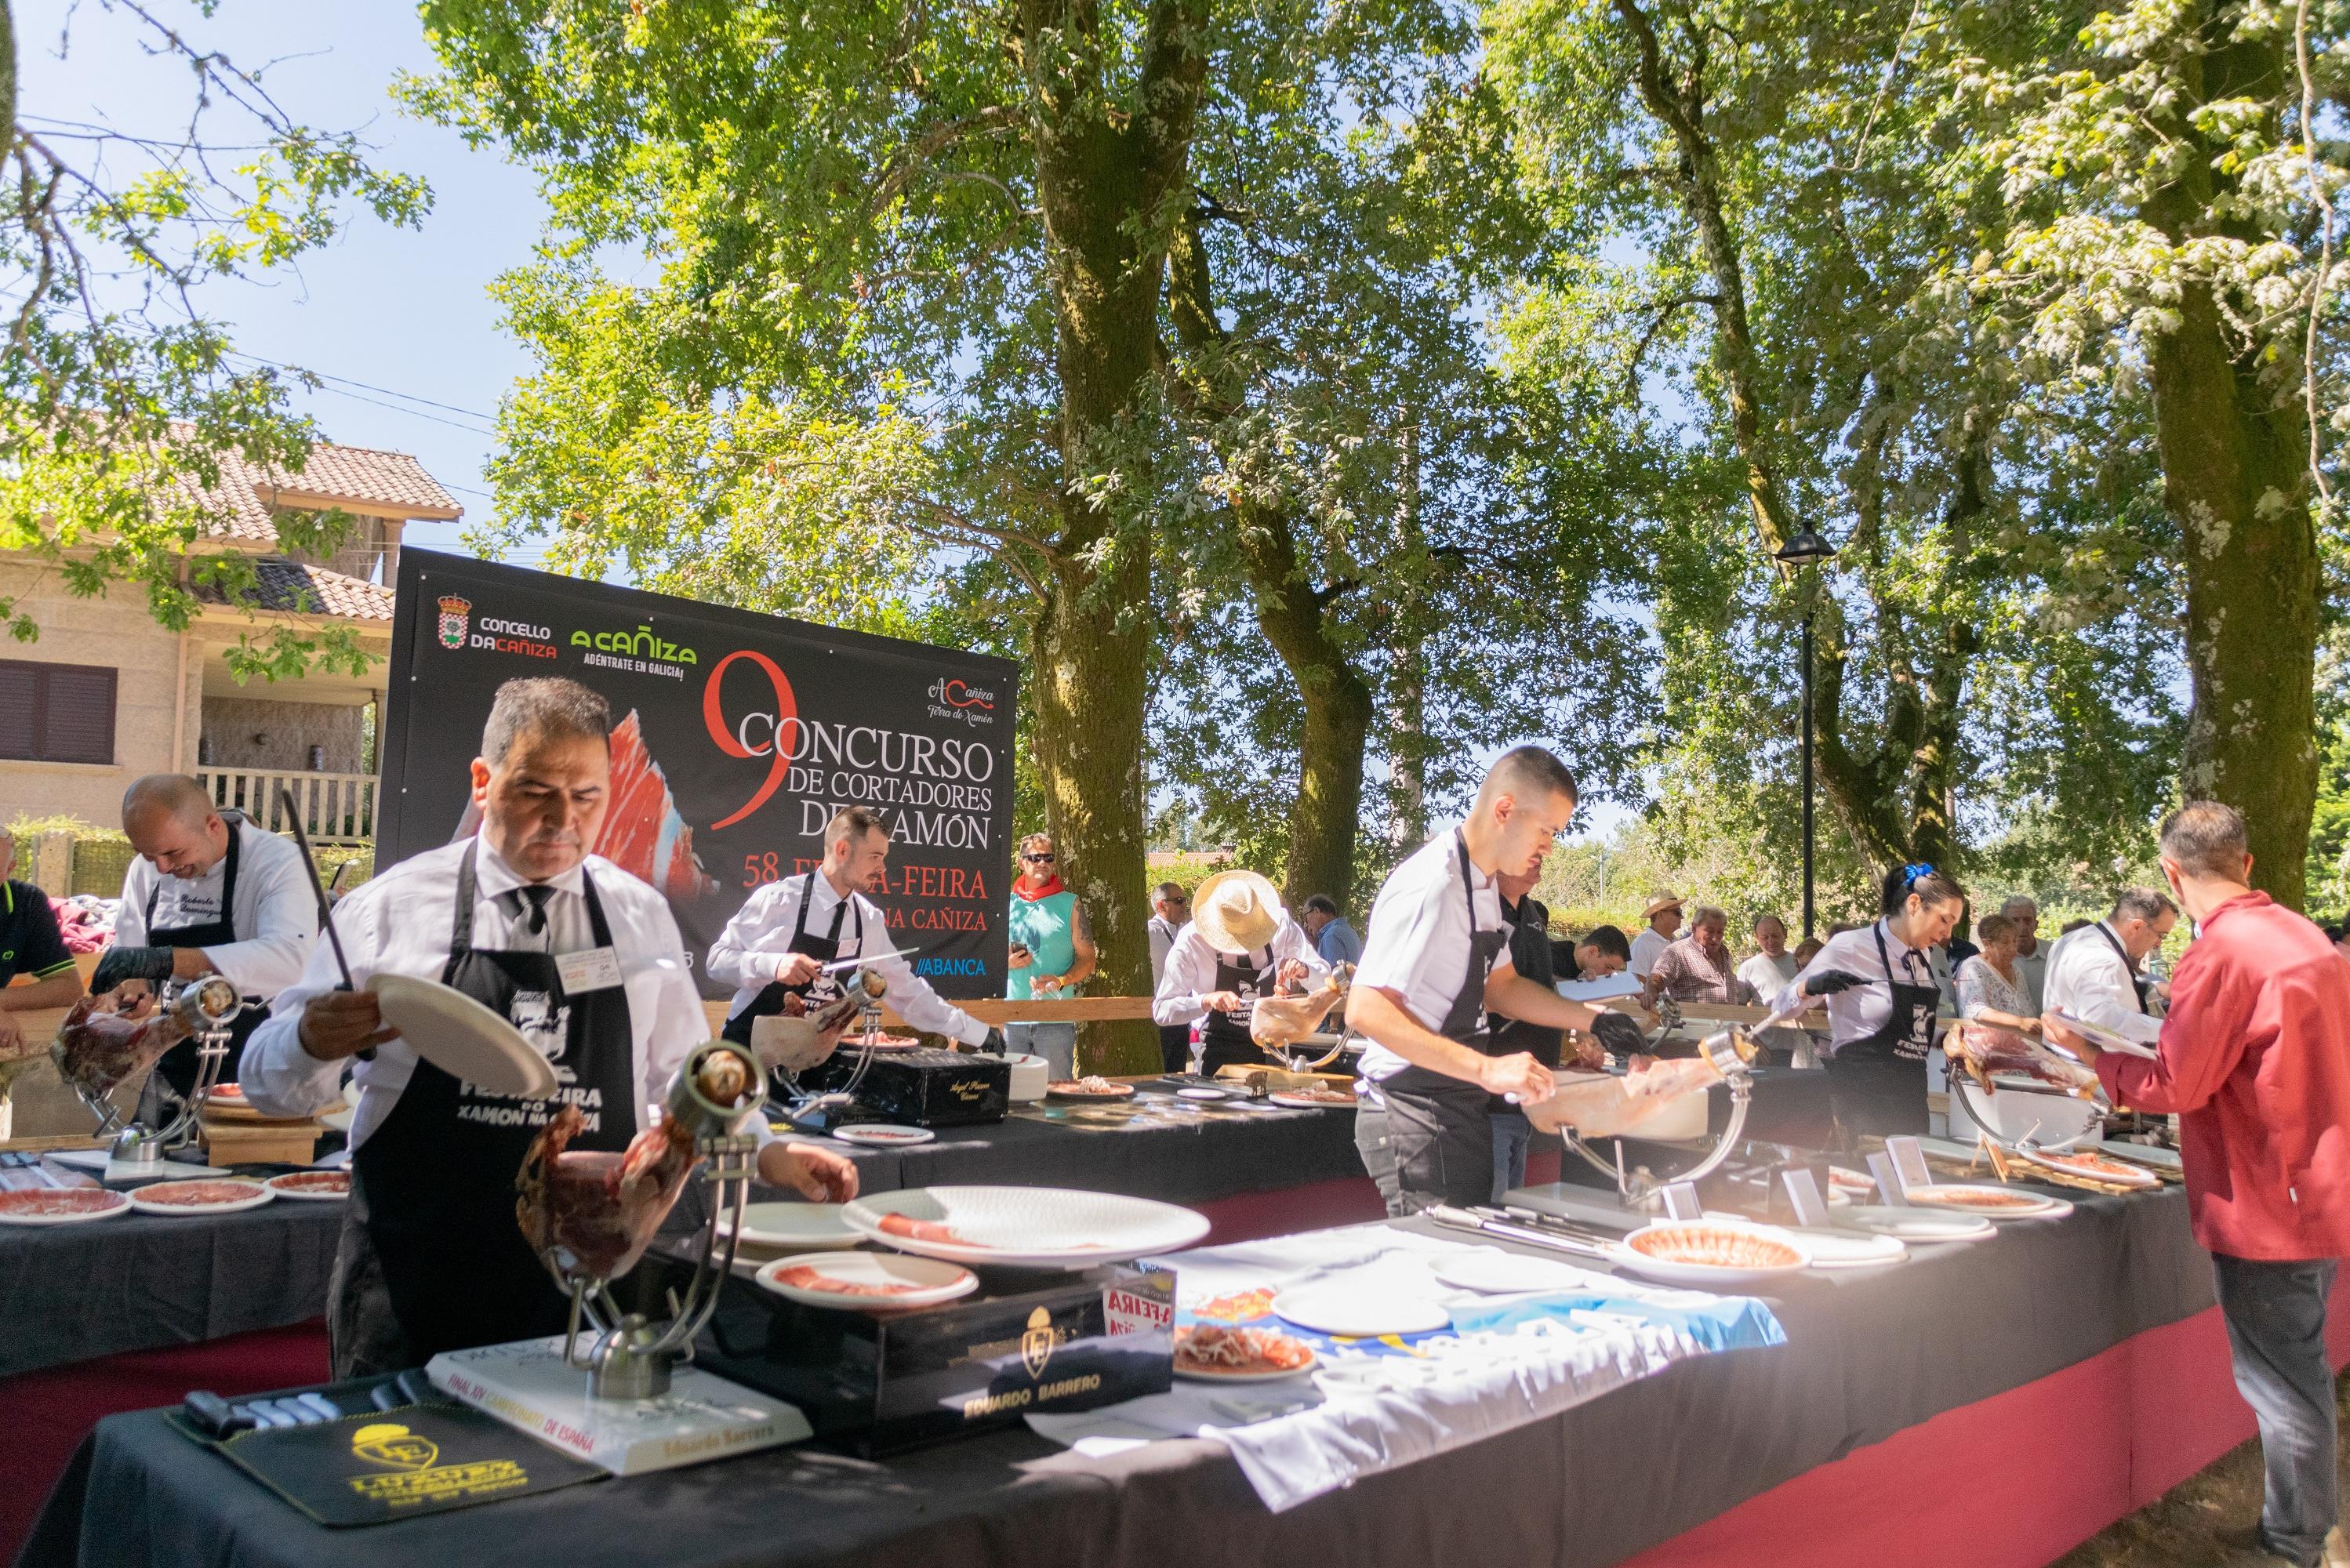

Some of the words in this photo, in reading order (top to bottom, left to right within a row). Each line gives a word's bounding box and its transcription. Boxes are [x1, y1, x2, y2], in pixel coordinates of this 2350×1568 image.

[480, 617, 551, 640] CONCELLO
[583, 652, 633, 671] ADÉNTRATE
[635, 660, 646, 673] EN
[928, 704, 952, 718] Terra
[953, 709, 963, 720] do
[963, 710, 993, 728] Xamón
[703, 650, 797, 831] 9
[739, 711, 993, 782] CONCURSO
[787, 766, 824, 795] DE
[830, 771, 992, 812] CORTADORES
[742, 851, 779, 887] 58
[911, 906, 988, 931] CAÑIZA
[448, 1374, 470, 1395] FINAL
[543, 1417, 559, 1436] DE
[558, 1424, 596, 1454] ESPAÑA
[964, 1387, 1032, 1418] EDUARDO
[1038, 1374, 1102, 1402] BARRERO
